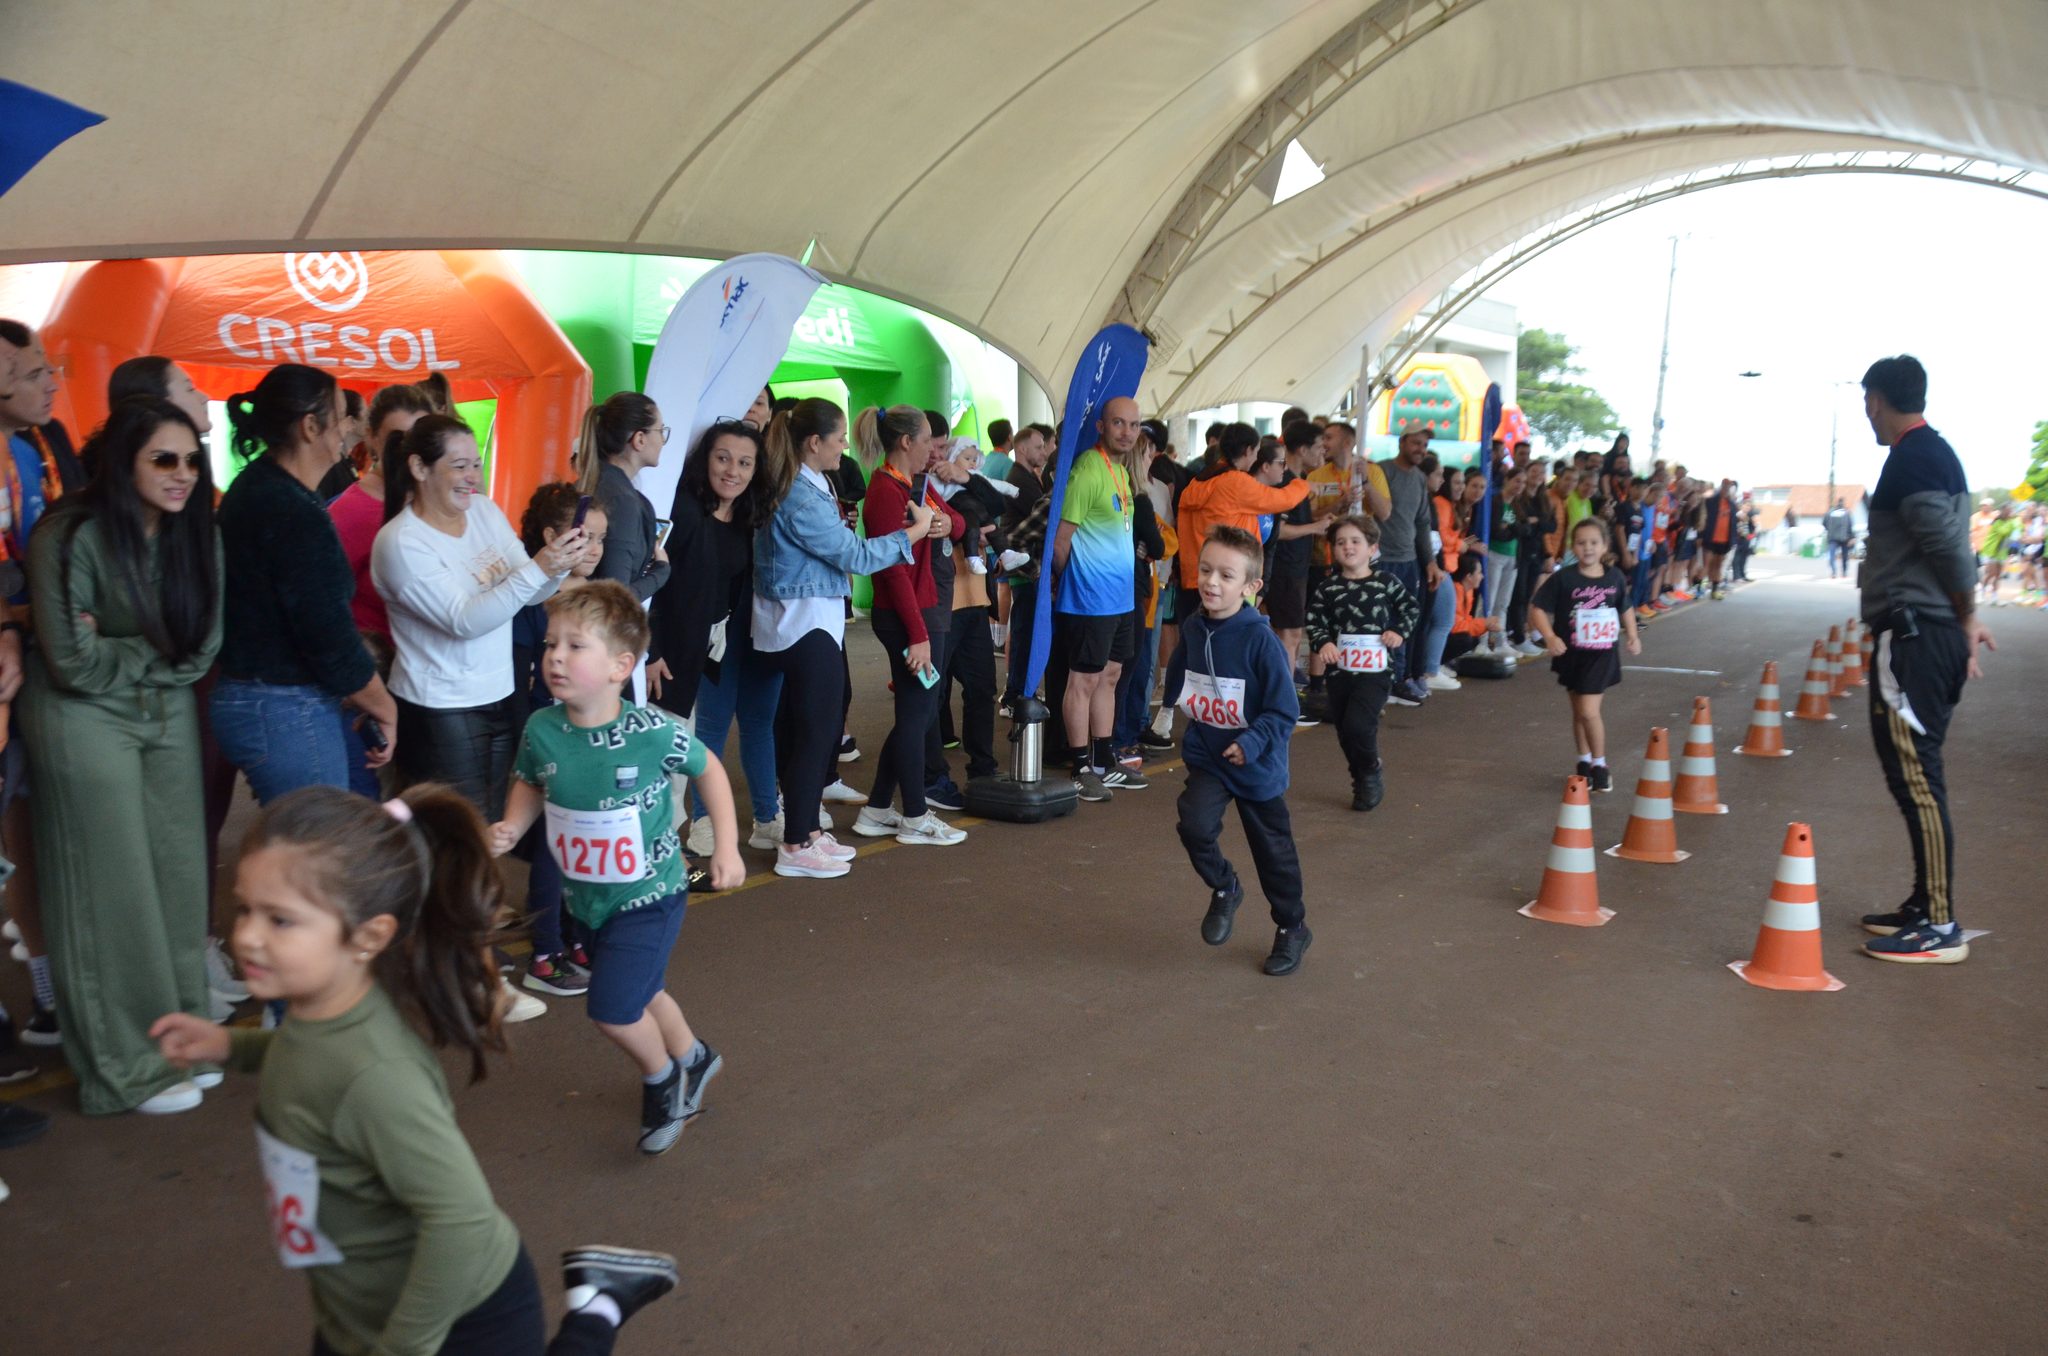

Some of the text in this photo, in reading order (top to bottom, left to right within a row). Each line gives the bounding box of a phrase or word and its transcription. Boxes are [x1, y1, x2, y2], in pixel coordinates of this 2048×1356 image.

[217, 313, 461, 371] CRESOL
[1340, 648, 1383, 669] 1221
[1186, 693, 1241, 727] 1268
[556, 832, 637, 876] 1276
